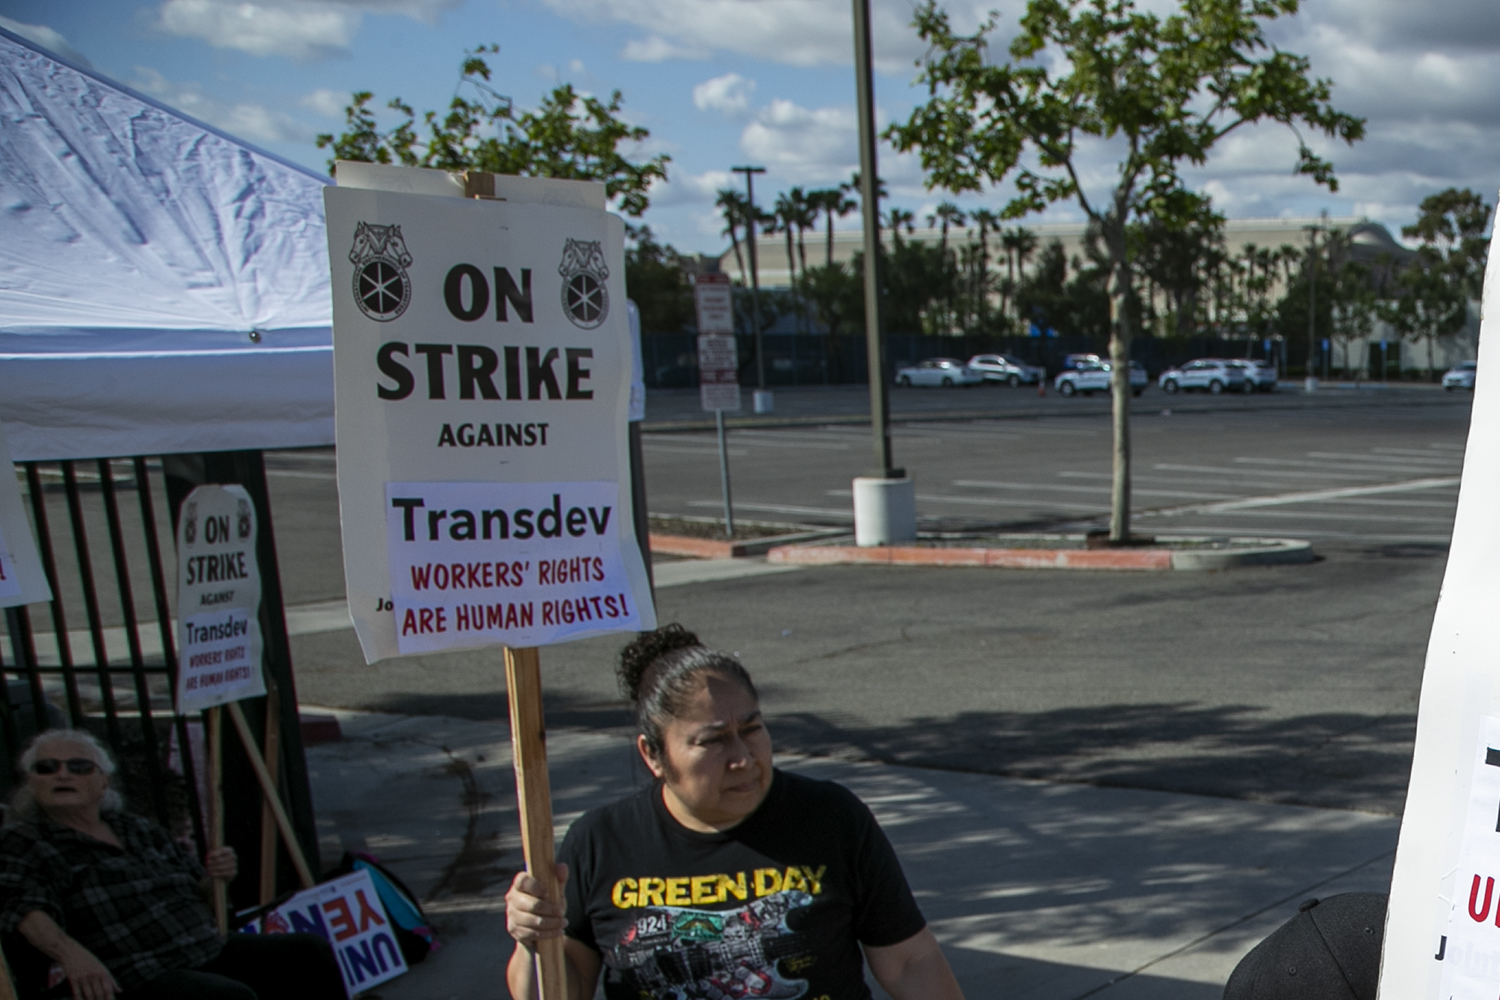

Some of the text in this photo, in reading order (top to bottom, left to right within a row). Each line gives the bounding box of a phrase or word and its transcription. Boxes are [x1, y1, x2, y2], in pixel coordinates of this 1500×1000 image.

[443, 263, 534, 323] ON
[376, 341, 595, 401] STRIKE
[437, 423, 549, 447] AGAINST
[205, 515, 230, 544] ON
[391, 493, 612, 541] Transdev
[186, 552, 248, 585] STRIKE
[411, 556, 605, 591] WORKERS' RIGHTS
[186, 615, 248, 645] Transdev
[402, 593, 629, 636] ARE HUMAN RIGHTS!
[611, 865, 826, 909] GREEN DAY
[637, 914, 668, 935] 924
